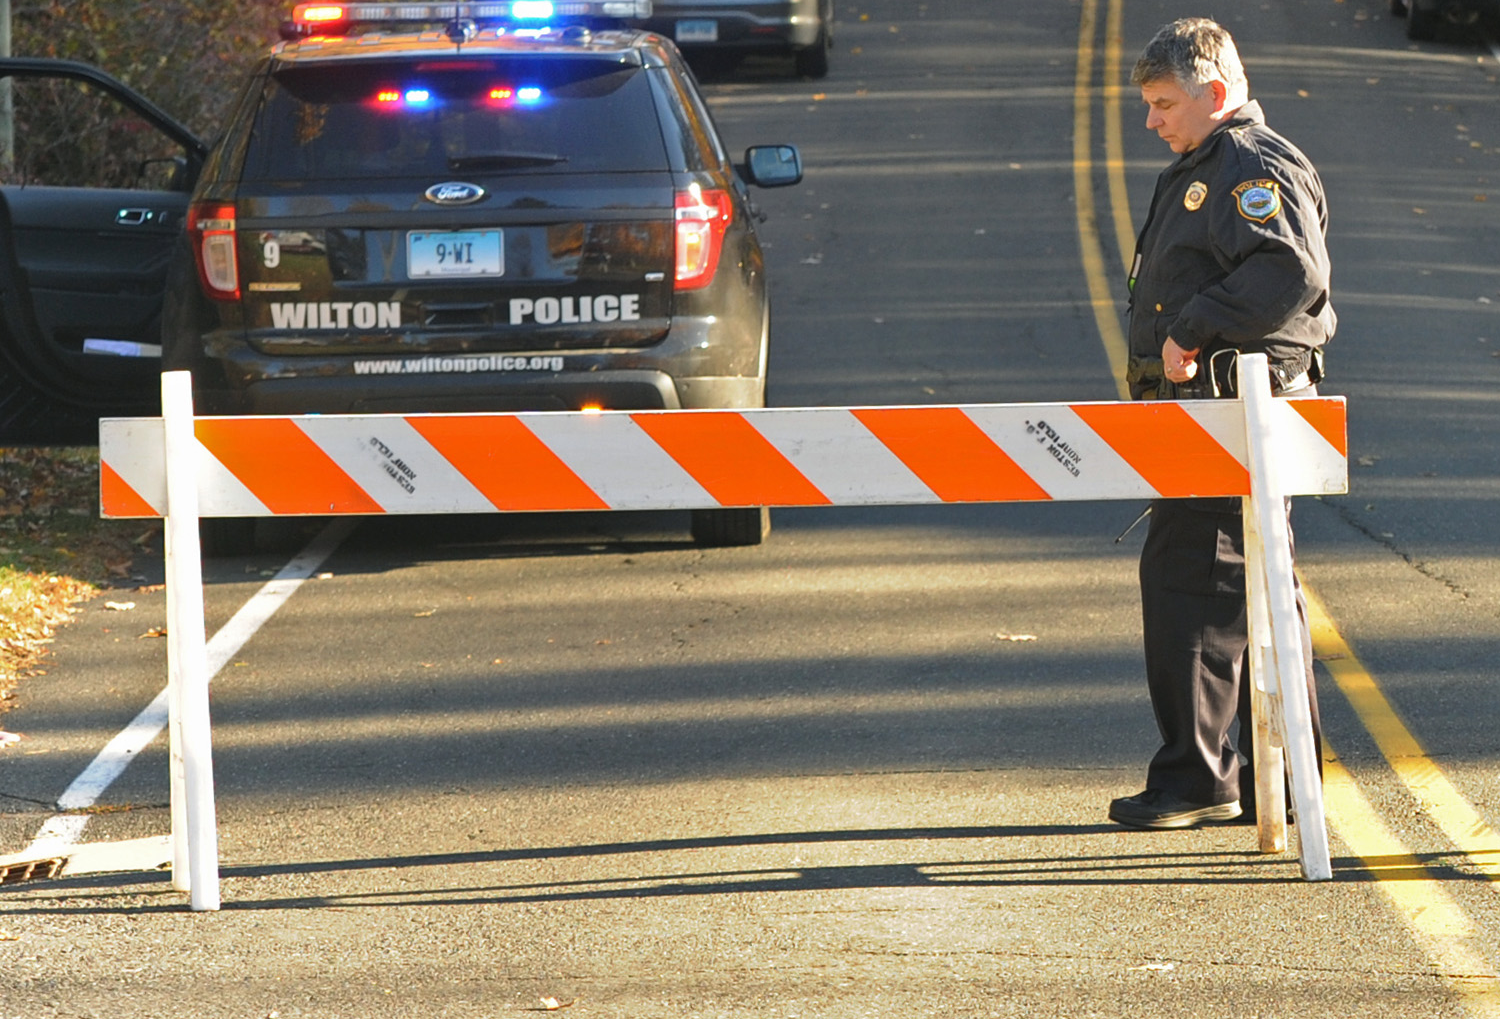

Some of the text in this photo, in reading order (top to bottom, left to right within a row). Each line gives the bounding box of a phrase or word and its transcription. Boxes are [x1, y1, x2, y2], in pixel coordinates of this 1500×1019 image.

[437, 185, 469, 200] Ford
[263, 240, 280, 268] 9
[270, 294, 641, 329] WILTON POLICE
[354, 356, 564, 374] www.wiltonpolice.org
[1046, 444, 1081, 477] WESTON
